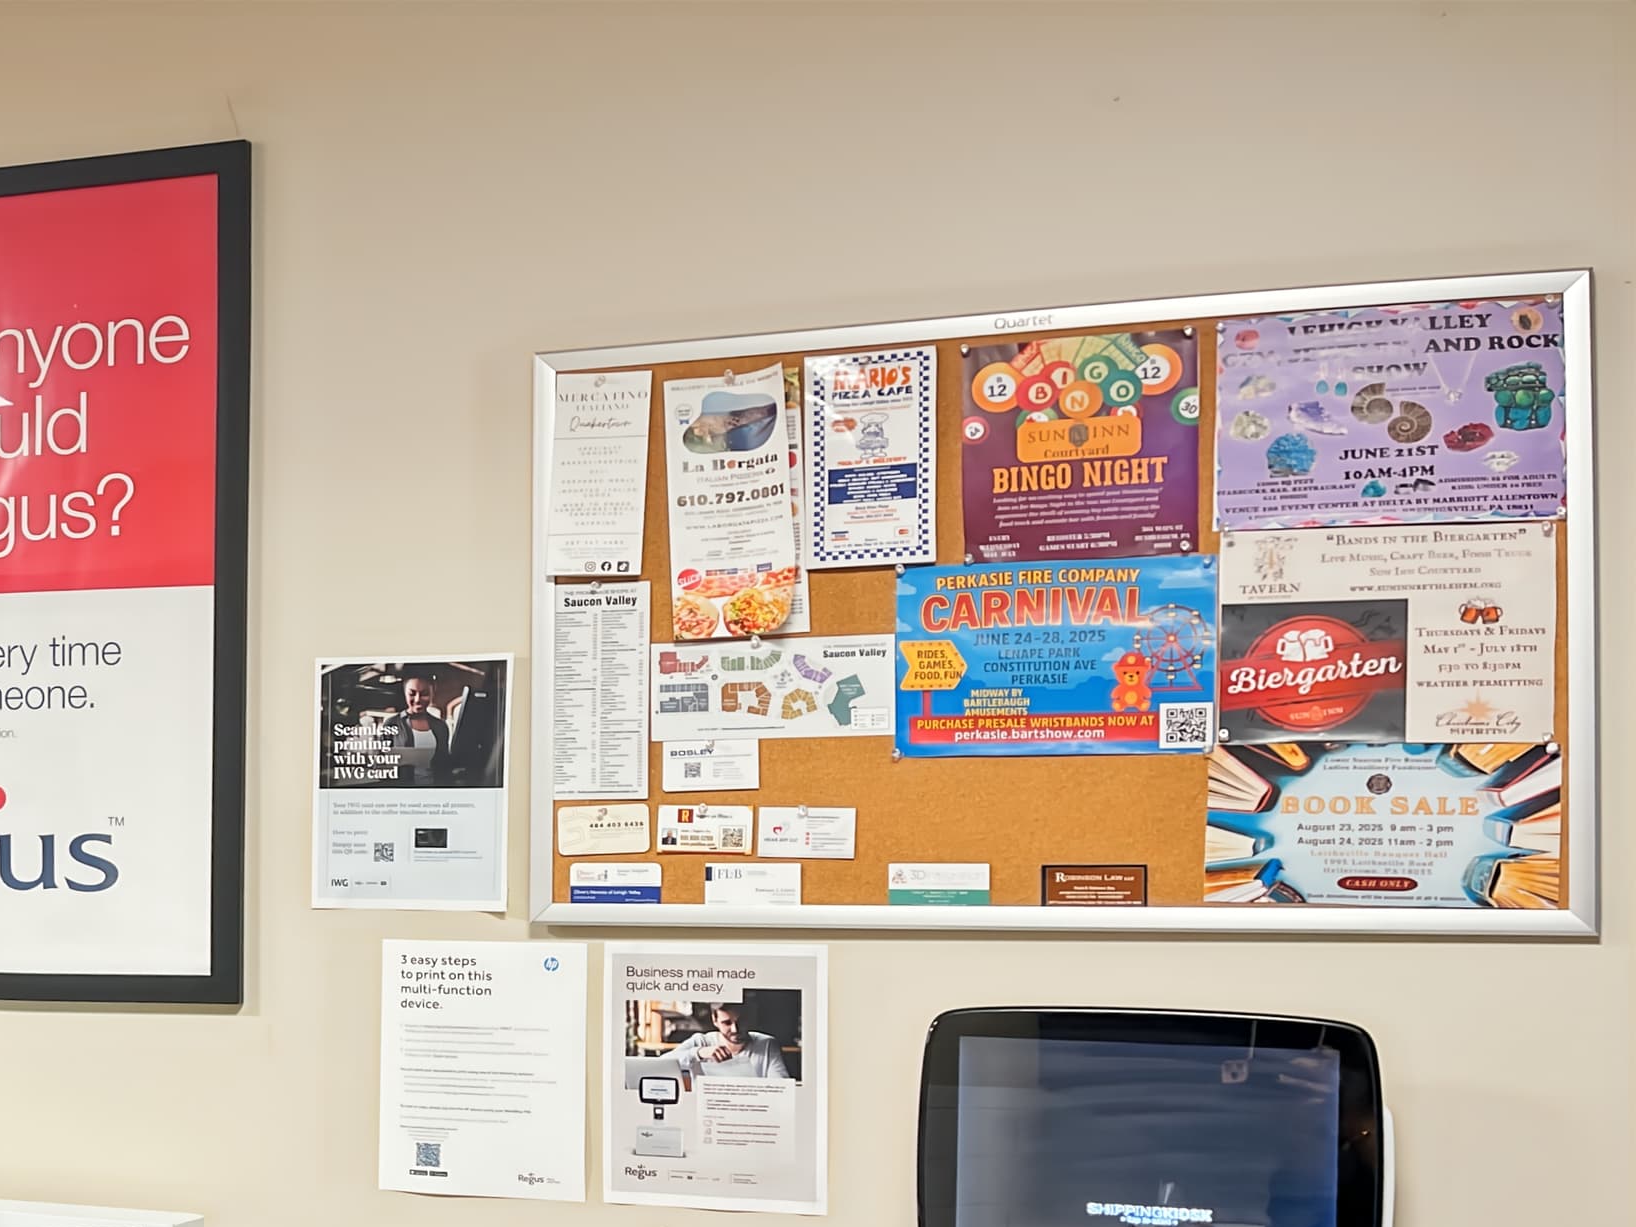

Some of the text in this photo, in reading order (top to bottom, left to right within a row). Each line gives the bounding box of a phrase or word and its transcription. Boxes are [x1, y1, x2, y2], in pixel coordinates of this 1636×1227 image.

[994, 315, 1054, 330] Quartet
[1425, 333, 1560, 354] AND ROCK
[1141, 366, 1161, 380] 12
[832, 385, 913, 400] PIZZA CAFE
[988, 384, 1007, 397] 12
[1028, 424, 1130, 443] SUN INN
[1044, 445, 1110, 458] Courtyard
[1339, 445, 1439, 461] JUNE 21ST
[682, 453, 779, 473] La Borgata
[992, 456, 1168, 494] BINGO NIGHT
[1343, 465, 1435, 481] 10AM-4PM
[1492, 493, 1558, 501] ALLENTOWN
[1382, 536, 1397, 544] IN
[1401, 533, 1428, 543] THE
[1390, 550, 1425, 561] CRAFT
[935, 568, 1140, 591] PERKASIE FIRE COMPANY
[1239, 582, 1301, 595] TAVERN
[564, 595, 637, 607] Saucon Valley
[921, 585, 1153, 633] CARNIVAL
[1415, 625, 1546, 637] THURSDAYS & FRIDAYS
[973, 633, 1010, 647] JUNE
[1068, 629, 1106, 643] 2025
[48, 634, 122, 668] time
[822, 648, 887, 658] Saucon Valley
[917, 649, 949, 661] RIDES,
[998, 647, 1081, 660] LENAPE PARK
[1423, 644, 1450, 655] MAY
[1477, 643, 1508, 656] JULY
[918, 660, 956, 671] GAMES,
[984, 660, 1097, 673] CONSTITUTION AVE
[914, 670, 963, 682] FOOD, FUN
[1011, 673, 1068, 685] PERKASIE
[1227, 652, 1403, 695] Biergarten
[1416, 679, 1544, 688] WEATHER PERMITTING
[970, 688, 1024, 698] MIDWAY BY
[964, 707, 1028, 716] AMUSEMENTS
[917, 714, 1155, 729] PURCHASE PRESALE WRISTBANDS NOW AT
[334, 723, 399, 736] Seamless
[954, 727, 1105, 742] perkasie.bartshow.com
[334, 737, 392, 753] printing
[670, 749, 714, 757] BOSLEY
[334, 753, 401, 767] with your
[334, 766, 399, 780] IWG card
[1280, 796, 1480, 816] BOOK SALE
[682, 810, 690, 822] R
[1297, 823, 1336, 833] August
[1339, 823, 1354, 833] 23,
[1358, 823, 1384, 832] 2025
[1390, 824, 1397, 832] 9
[1426, 824, 1433, 832] 3
[1436, 825, 1454, 834] pm
[1297, 836, 1336, 847] August
[1358, 837, 1384, 846] 2025
[1387, 837, 1416, 846] 11am
[1426, 838, 1433, 846] 2
[1436, 839, 1454, 848] pm
[331, 878, 349, 887] IWG
[1345, 879, 1412, 888] CASH ONLY
[401, 955, 477, 968] 3 easy steps
[401, 970, 493, 981] to print on this
[626, 966, 756, 979] Business mail made
[401, 984, 492, 996] multi-function
[626, 980, 661, 992] quick
[664, 981, 689, 991] and
[401, 998, 443, 1010] device.
[518, 1174, 544, 1185] Regus
[624, 1166, 657, 1180] Regus
[1086, 1202, 1213, 1222] SHIPPINGKIOSK
